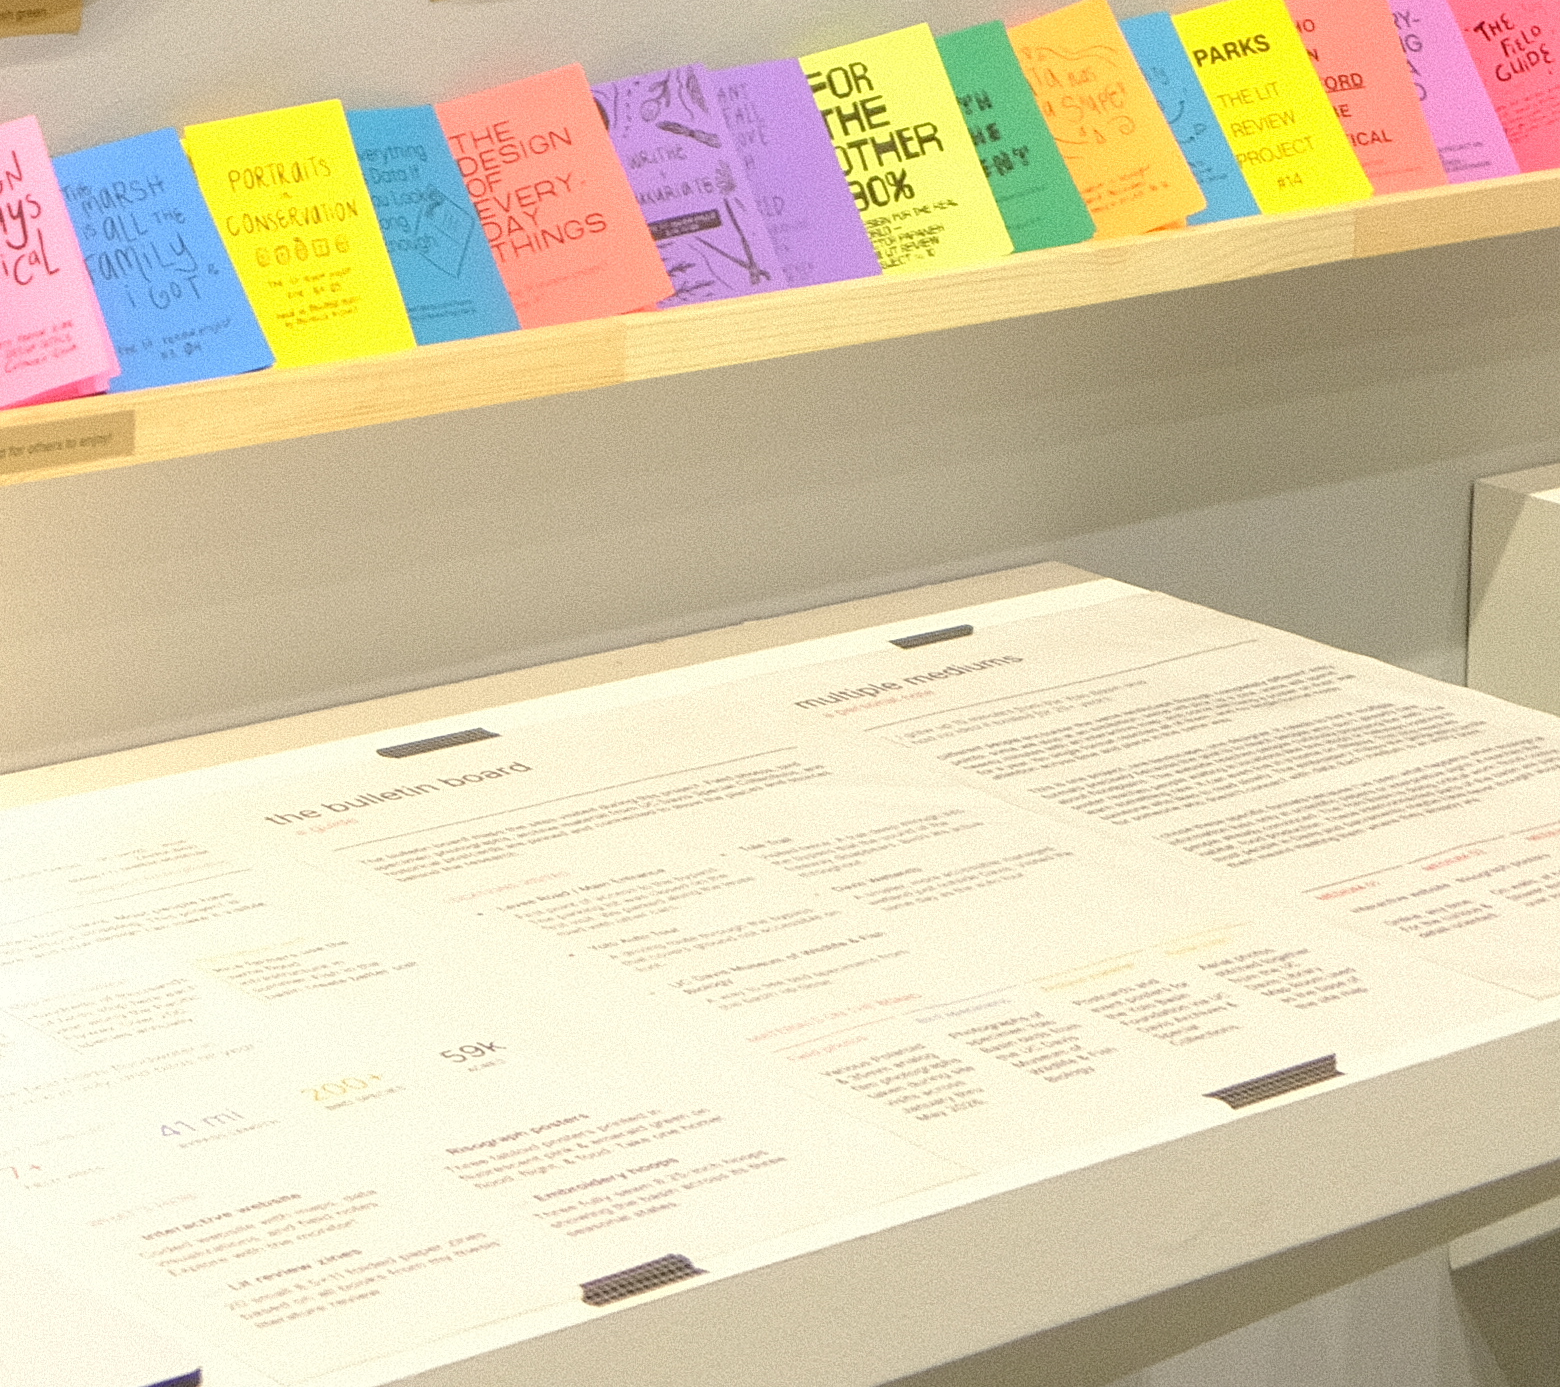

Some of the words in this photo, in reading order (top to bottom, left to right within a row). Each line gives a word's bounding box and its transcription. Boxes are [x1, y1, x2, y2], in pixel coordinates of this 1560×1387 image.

[1473, 12, 1515, 42] THE
[1192, 33, 1272, 68] PARKS
[1494, 43, 1555, 82] GUIDE
[805, 61, 875, 100] FOR
[1216, 87, 1254, 110] THE
[1255, 80, 1279, 101] LIT
[819, 94, 891, 141] THE
[1229, 110, 1296, 139] REVIEW
[448, 120, 516, 154] THE
[455, 127, 574, 178] DESIGN
[834, 121, 945, 178] OTHER
[1235, 135, 1315, 170] PROJECT
[466, 169, 503, 199] OF
[226, 197, 360, 237] CONSERVATION
[481, 206, 540, 243] DAY
[490, 211, 608, 263] THINGS
[794, 678, 904, 710] multiple
[903, 654, 1024, 687] mediums
[263, 807, 323, 826] the
[320, 781, 441, 813] bulletin
[436, 760, 533, 788] board
[440, 1039, 507, 1064] 59k
